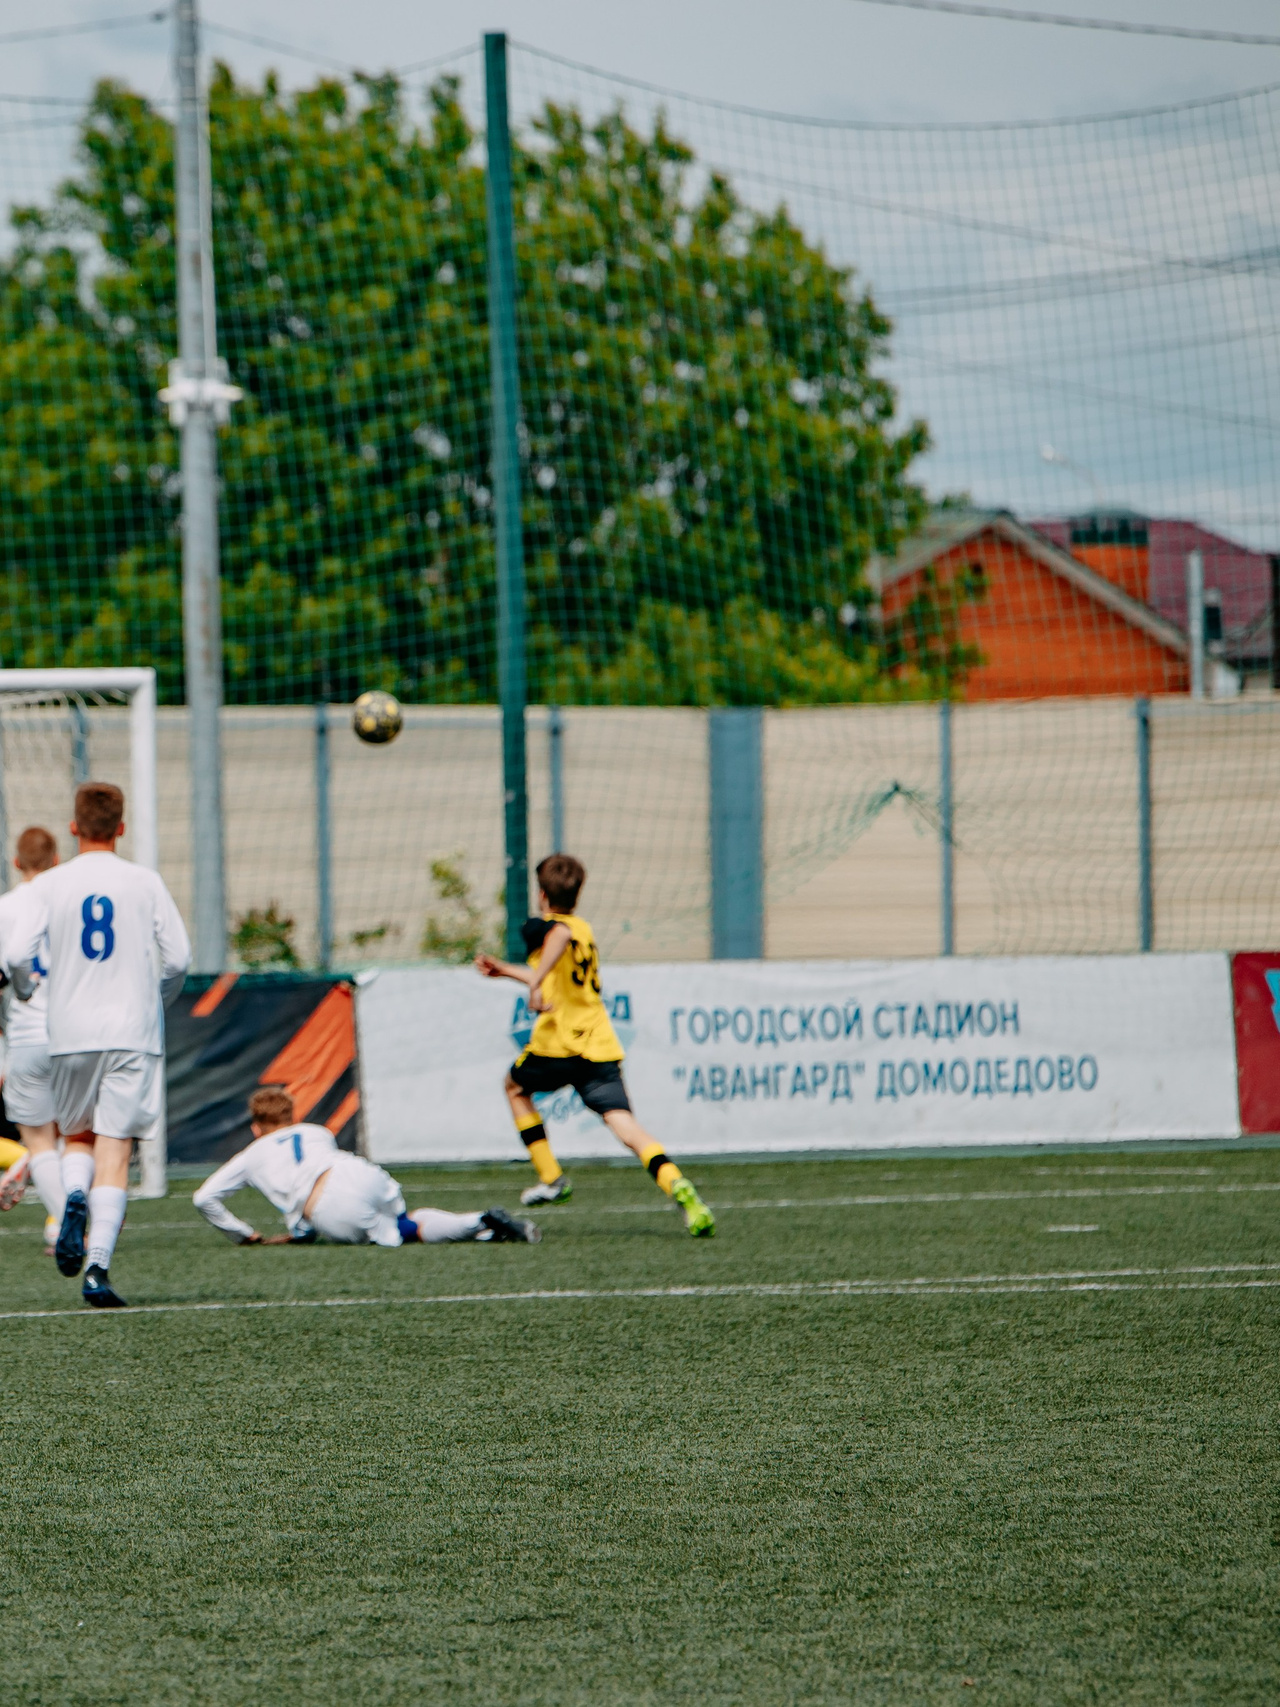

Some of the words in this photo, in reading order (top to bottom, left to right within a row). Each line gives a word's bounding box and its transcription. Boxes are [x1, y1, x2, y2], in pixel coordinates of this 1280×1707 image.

[81, 894, 115, 962] 8
[669, 998, 864, 1048] ГОРОДСКОЙ
[872, 999, 1020, 1043] СТАДИОН
[672, 1060, 866, 1102] "АВАНГАРД"
[874, 1053, 1099, 1101] ДОМОДЕДОВО
[276, 1133, 304, 1164] 7
